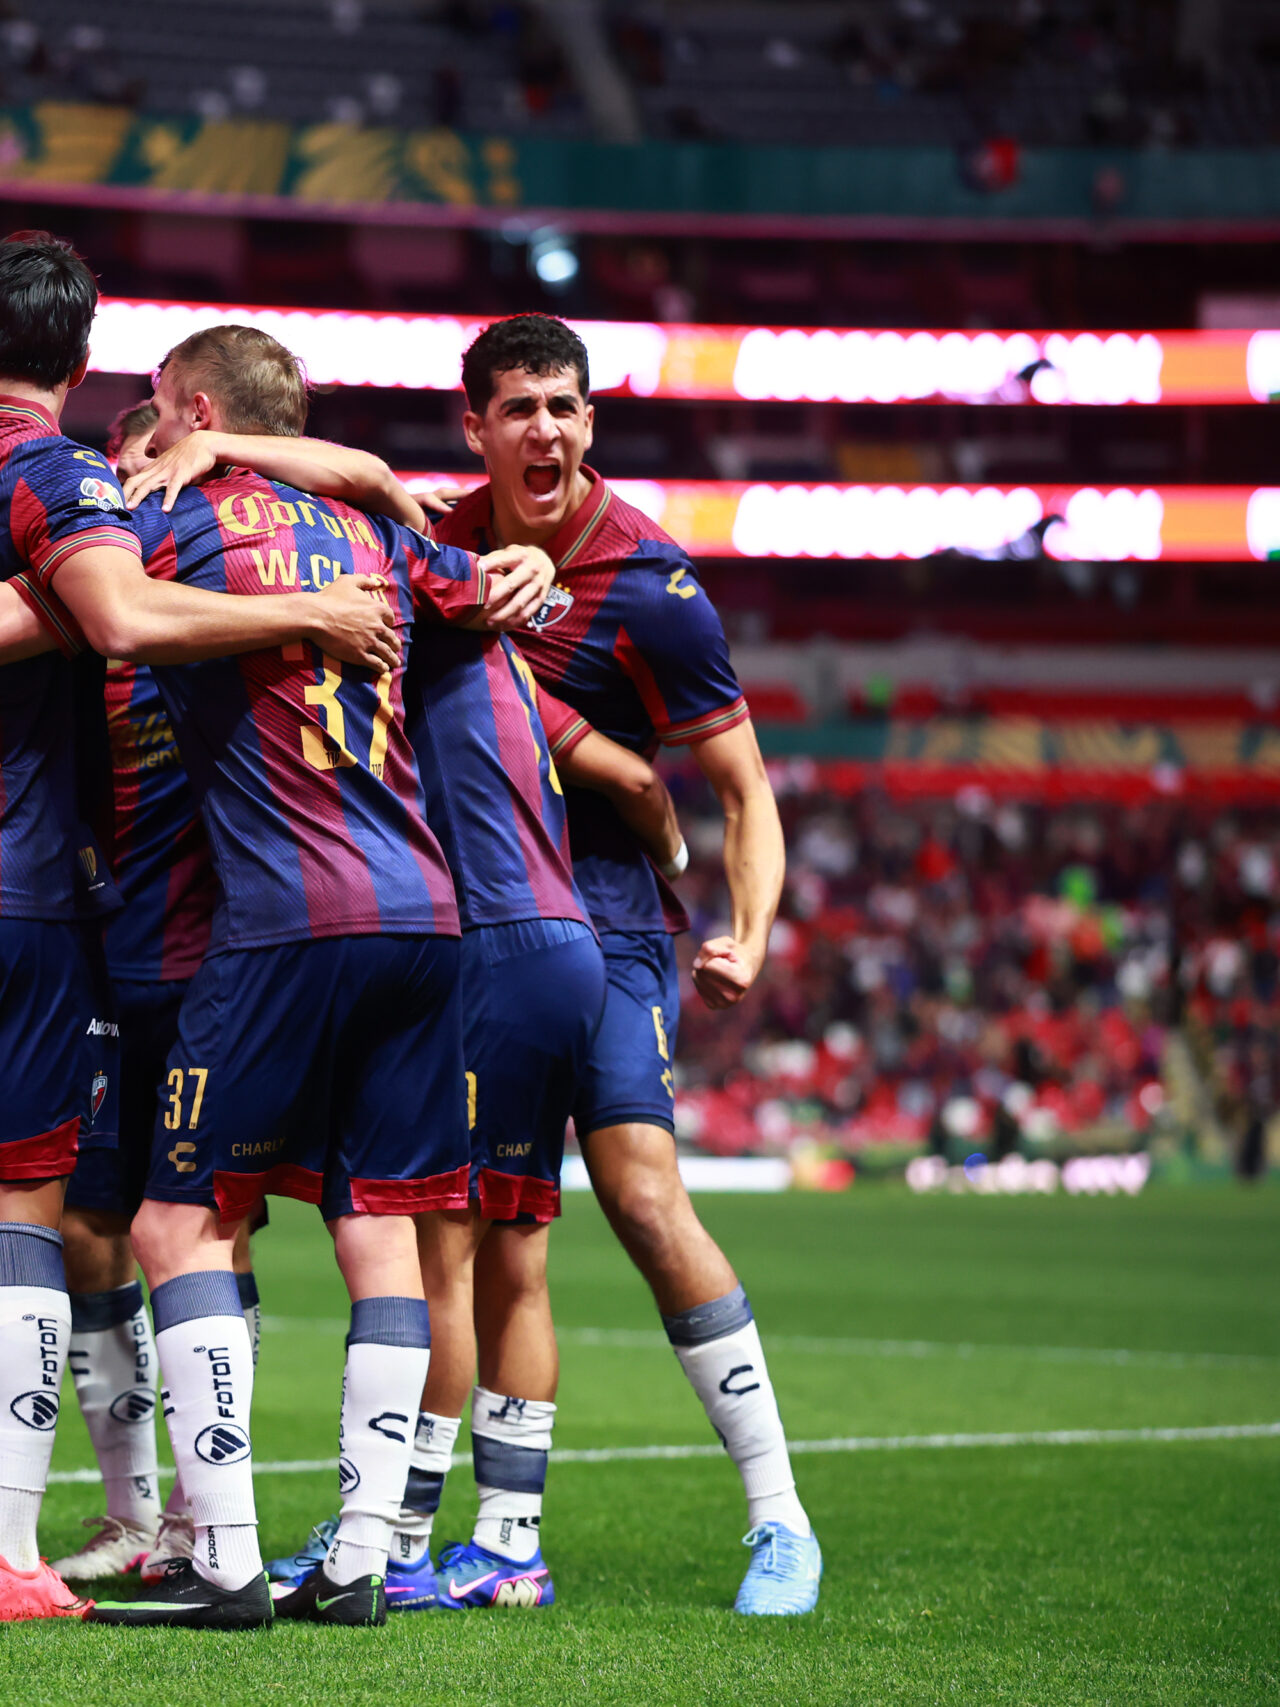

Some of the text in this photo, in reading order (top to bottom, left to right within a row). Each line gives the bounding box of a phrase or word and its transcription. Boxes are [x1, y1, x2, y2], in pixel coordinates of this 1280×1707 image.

[217, 491, 380, 552] Corona
[281, 639, 394, 781] 37
[164, 1068, 208, 1130] 37
[38, 1317, 58, 1386] FOTON
[207, 1347, 236, 1419] FOTON
